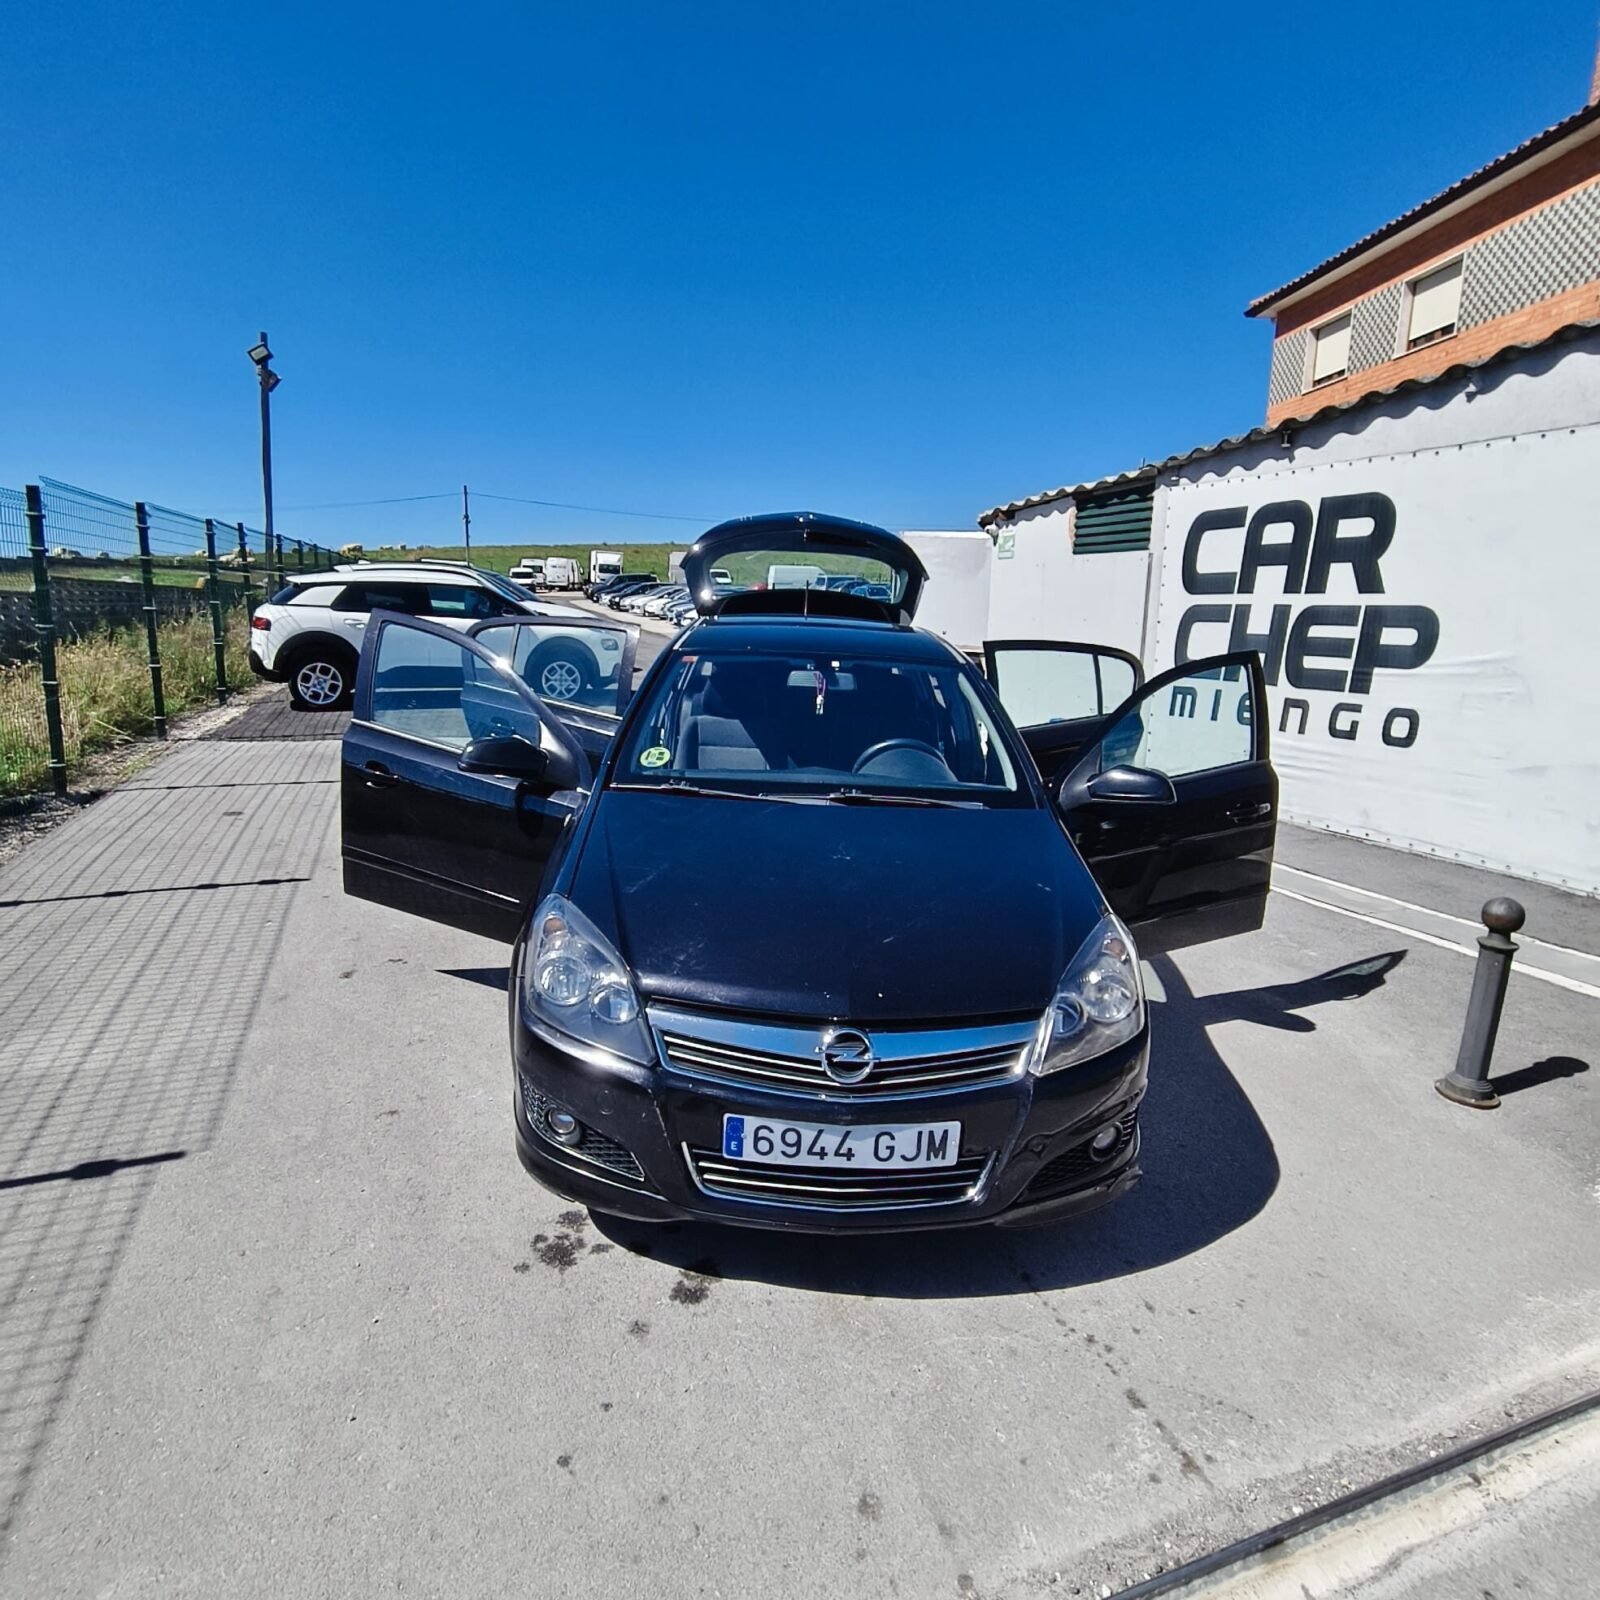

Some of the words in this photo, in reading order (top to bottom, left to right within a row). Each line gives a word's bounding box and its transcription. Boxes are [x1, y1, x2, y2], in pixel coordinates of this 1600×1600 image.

[1182, 492, 1397, 595] CAR
[1174, 604, 1440, 695] CHEP
[731, 1141, 738, 1151] E
[752, 1124, 855, 1162] 6944
[873, 1129, 949, 1162] GJM
